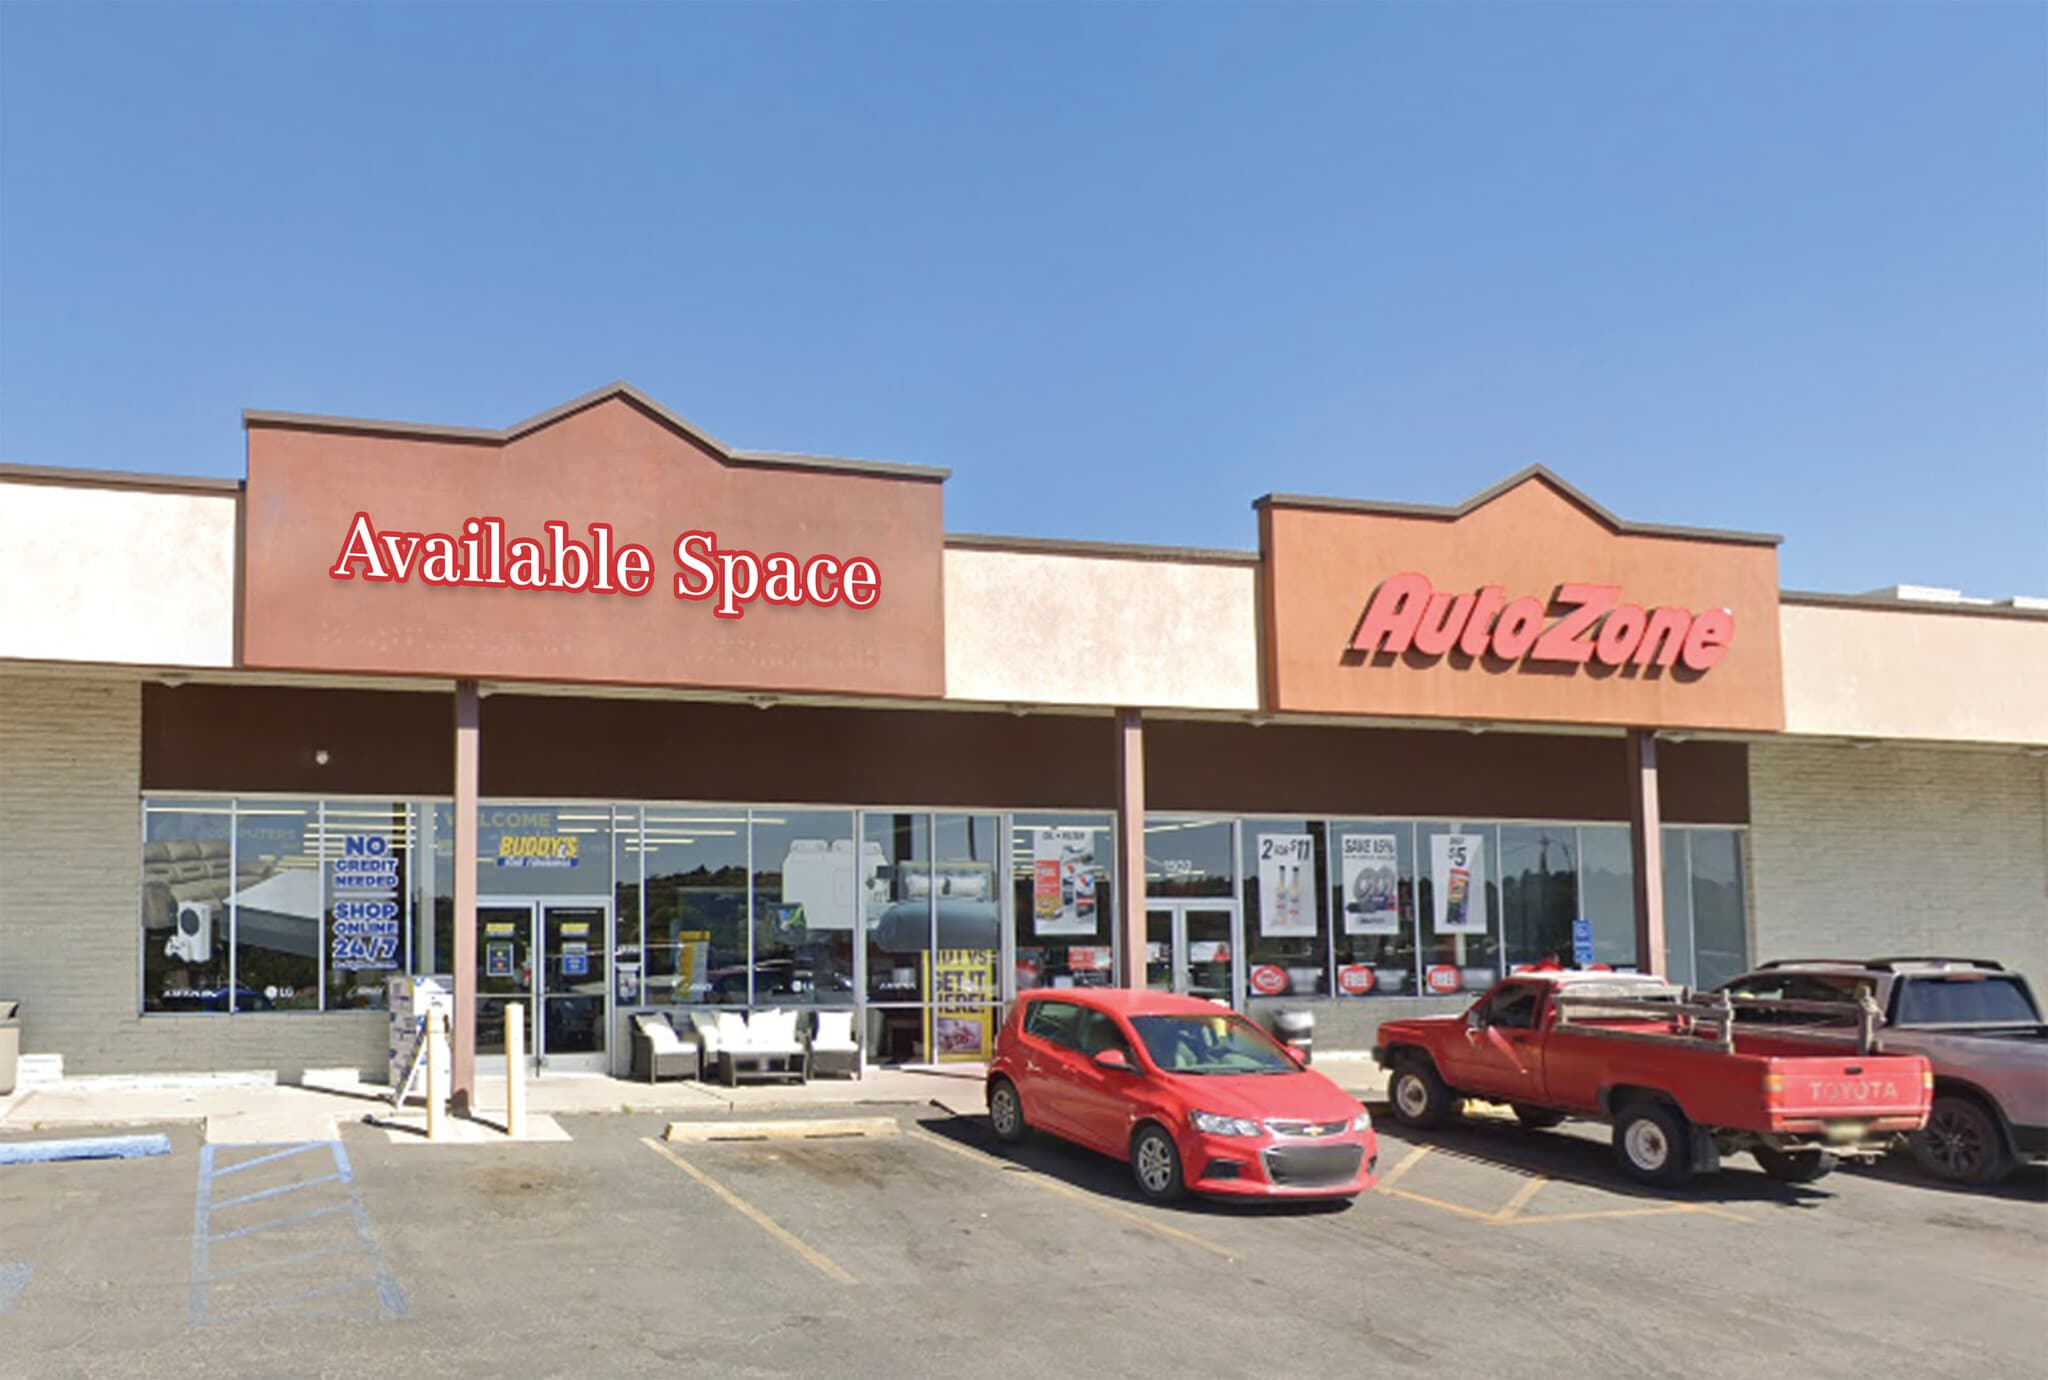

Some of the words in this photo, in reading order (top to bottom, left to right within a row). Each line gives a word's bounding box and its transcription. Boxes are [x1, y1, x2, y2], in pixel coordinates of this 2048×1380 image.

[331, 513, 652, 593] Available
[675, 532, 879, 617] Space
[1350, 572, 1736, 671] AutoZone
[345, 835, 387, 857] NO
[500, 836, 579, 858] BUDDY'S
[1261, 839, 1274, 860] 2
[1345, 839, 1370, 854] SAVE
[335, 859, 396, 872] CREDIT
[335, 875, 396, 888] NEEDED
[335, 902, 397, 919] SHOP
[335, 921, 397, 935] ONLINE
[334, 937, 397, 958] 24/7
[1809, 1081, 1898, 1101] TOYOTA
